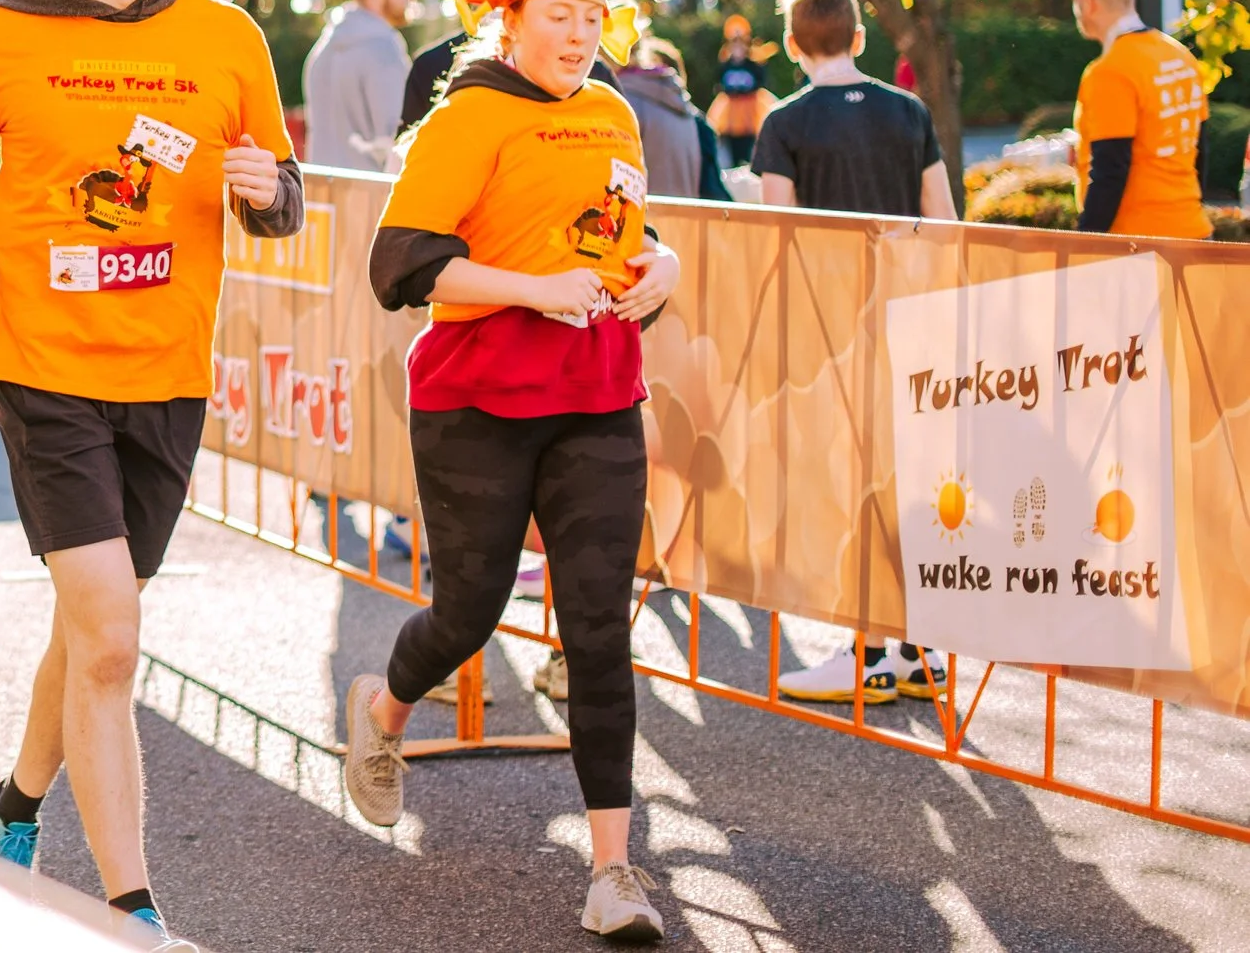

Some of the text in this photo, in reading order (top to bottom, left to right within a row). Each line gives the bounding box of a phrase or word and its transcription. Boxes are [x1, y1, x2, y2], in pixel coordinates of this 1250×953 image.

[47, 75, 199, 93] Turkey Trot 5k
[65, 93, 188, 106] Thanksgiving Day
[141, 120, 192, 149] Turkey Trot
[536, 128, 590, 142] Turkey
[100, 250, 170, 284] 9340
[909, 334, 1149, 414] Turkey Trot
[259, 345, 352, 455] Trot
[918, 555, 1161, 600] wake run feast
